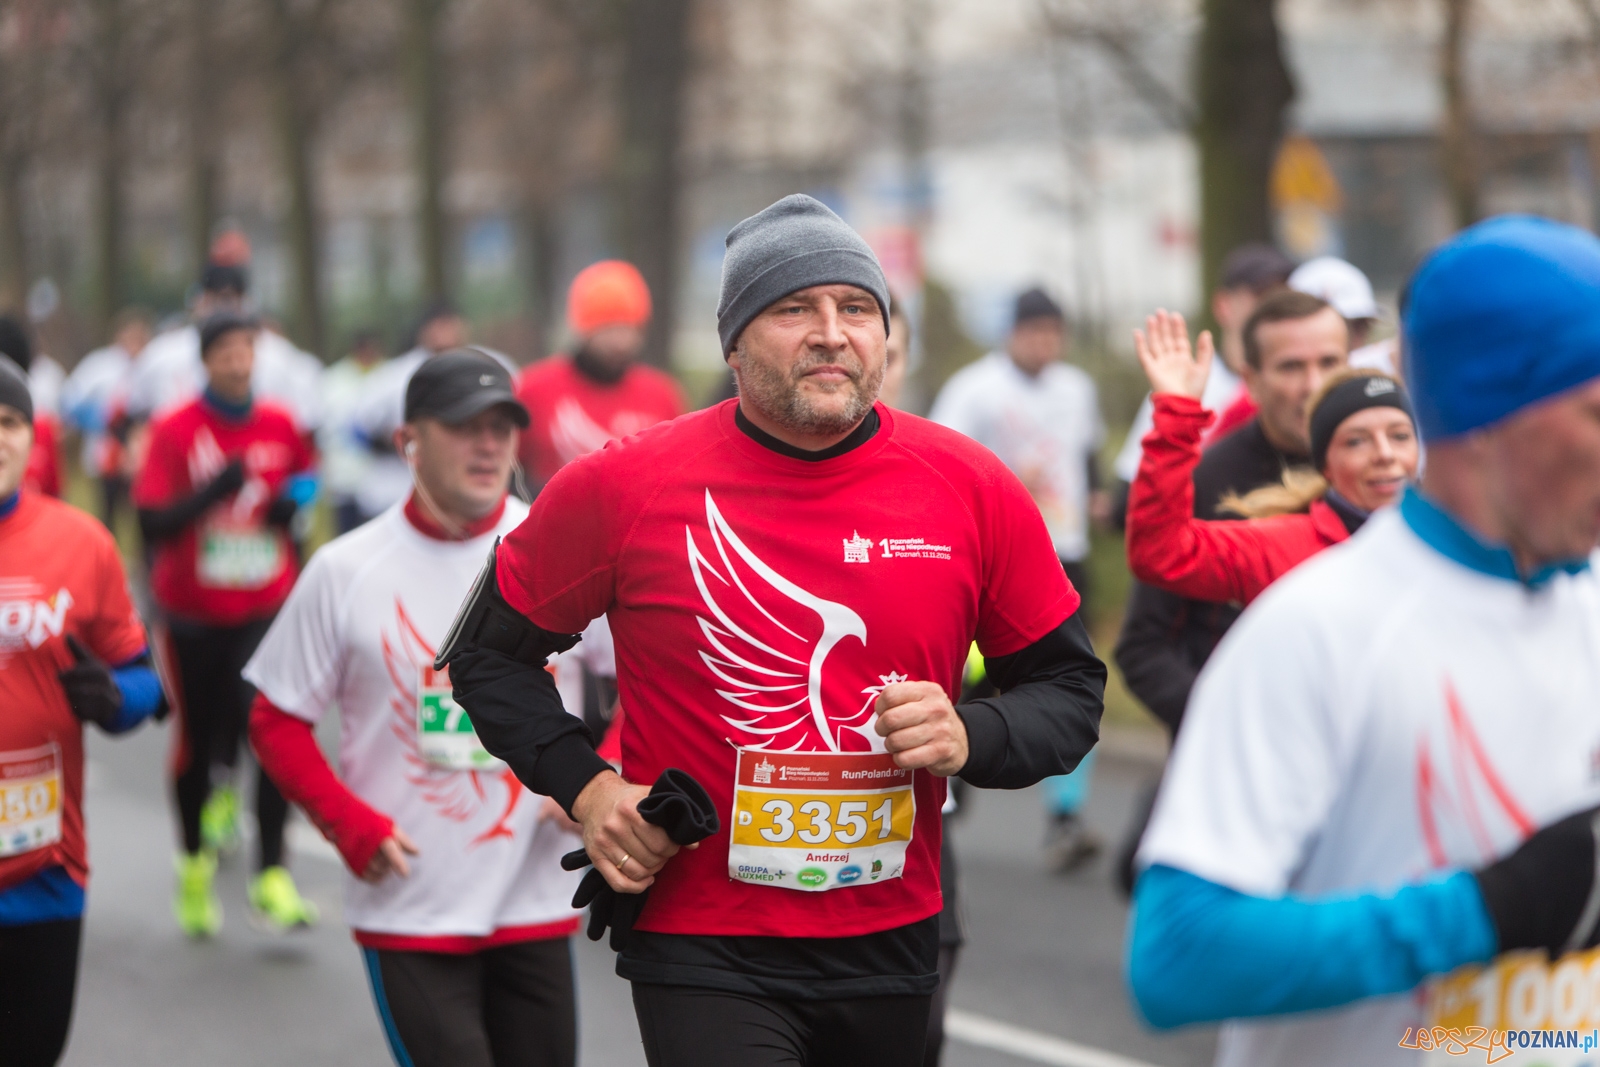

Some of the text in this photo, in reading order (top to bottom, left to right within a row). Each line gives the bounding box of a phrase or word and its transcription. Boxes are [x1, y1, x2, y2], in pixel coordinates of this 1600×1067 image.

[879, 538, 893, 558] 1
[779, 765, 787, 780] 1
[841, 768, 906, 779] RunPoland.org
[738, 798, 893, 844] D 3351
[806, 853, 850, 863] Andrzej
[738, 865, 768, 874] GRUPA
[738, 872, 774, 881] LUXMED
[801, 874, 825, 883] energy
